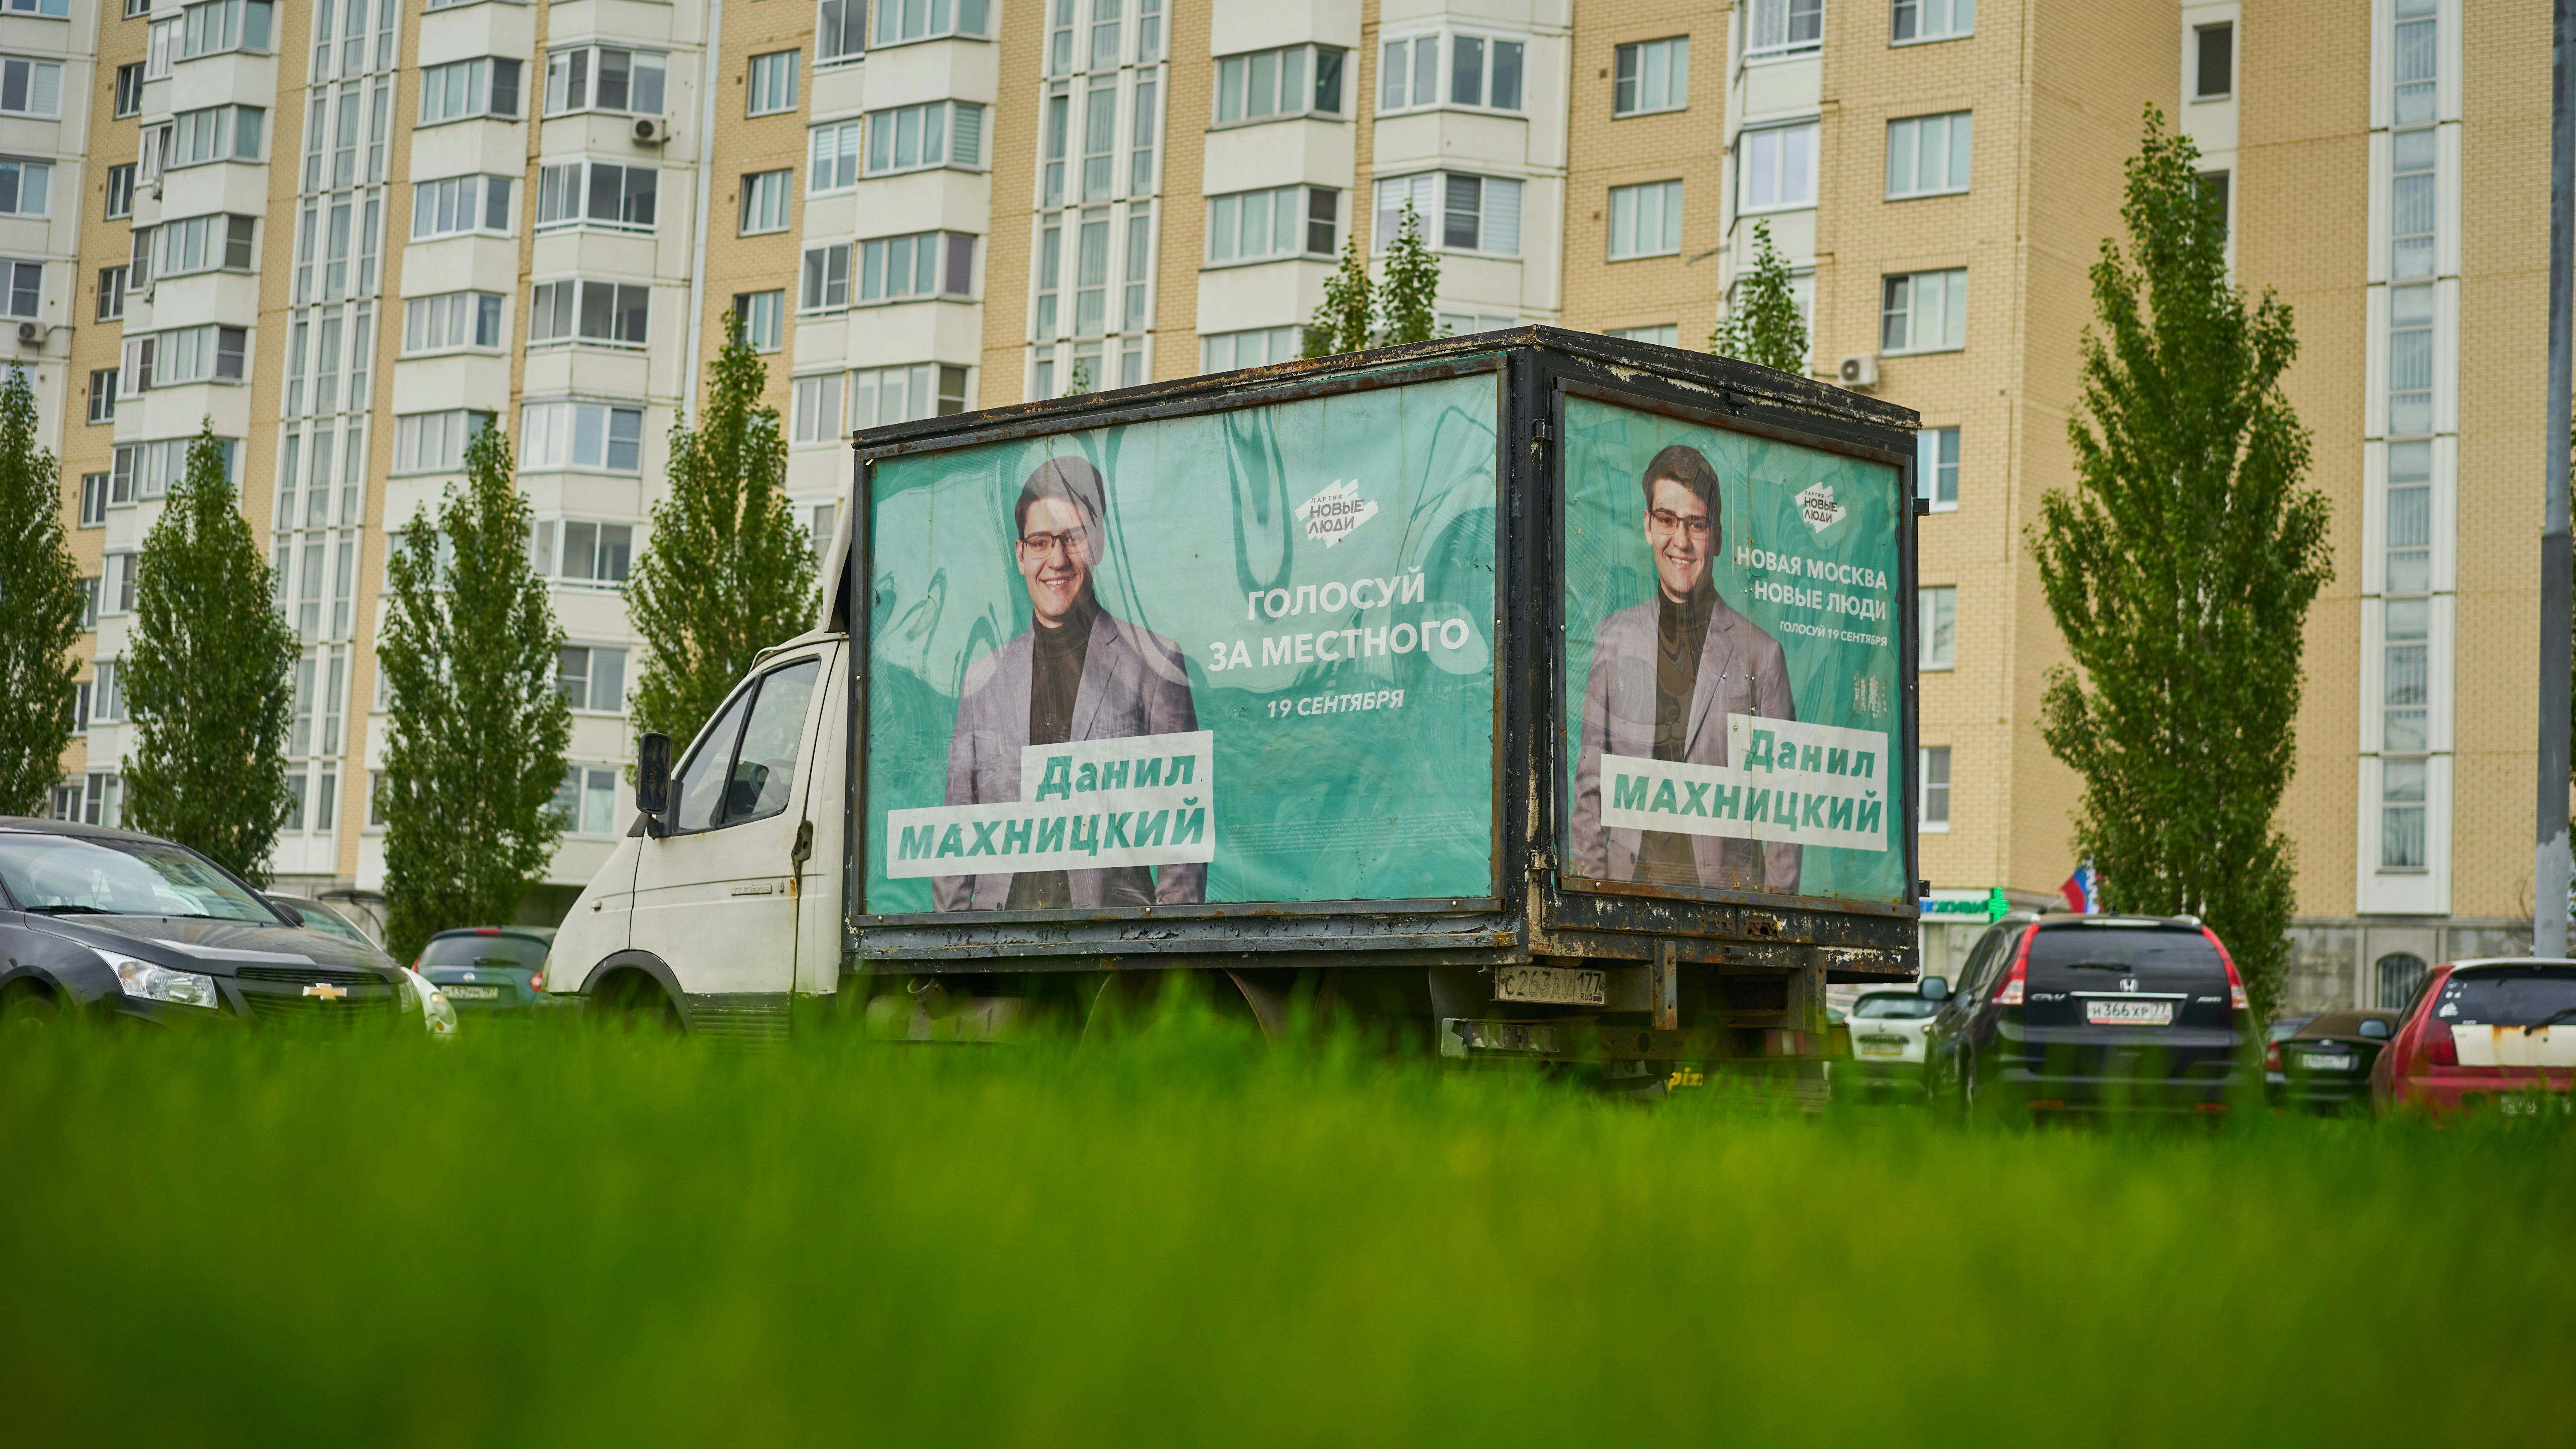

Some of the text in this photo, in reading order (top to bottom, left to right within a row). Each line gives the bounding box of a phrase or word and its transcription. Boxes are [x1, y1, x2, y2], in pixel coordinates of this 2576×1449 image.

[1310, 499, 1364, 519] НОВЫЕ
[1311, 494, 1342, 504] ПАРТИЯ
[1804, 497, 1838, 512] НОВЫЕ
[1309, 516, 1354, 535] ЛЮДИ
[1804, 509, 1832, 523] ЛЮДИ
[1737, 546, 1887, 590] НОВАЯ МОСКВА
[1248, 565, 1425, 620] ГОЛОСУЙ
[1755, 580, 1886, 622] НОВЫЕ ЛЮДИ
[1208, 618, 1469, 671] ЗА МЕСТНОГО
[1780, 621, 1887, 647] ГОЛОСУЙ 19 СЕНТЯБРЯ
[1267, 689, 1405, 718] 19 СЕНТЯБРЯ
[1743, 729, 1876, 778] Данил
[1035, 754, 1196, 802] Данил
[1613, 774, 1882, 834] МАХНИЦКИЙ
[898, 796, 1206, 860] МАХНИЦКИЙ
[1577, 972, 1601, 993] 177
[1668, 1067, 1703, 1091] piz
